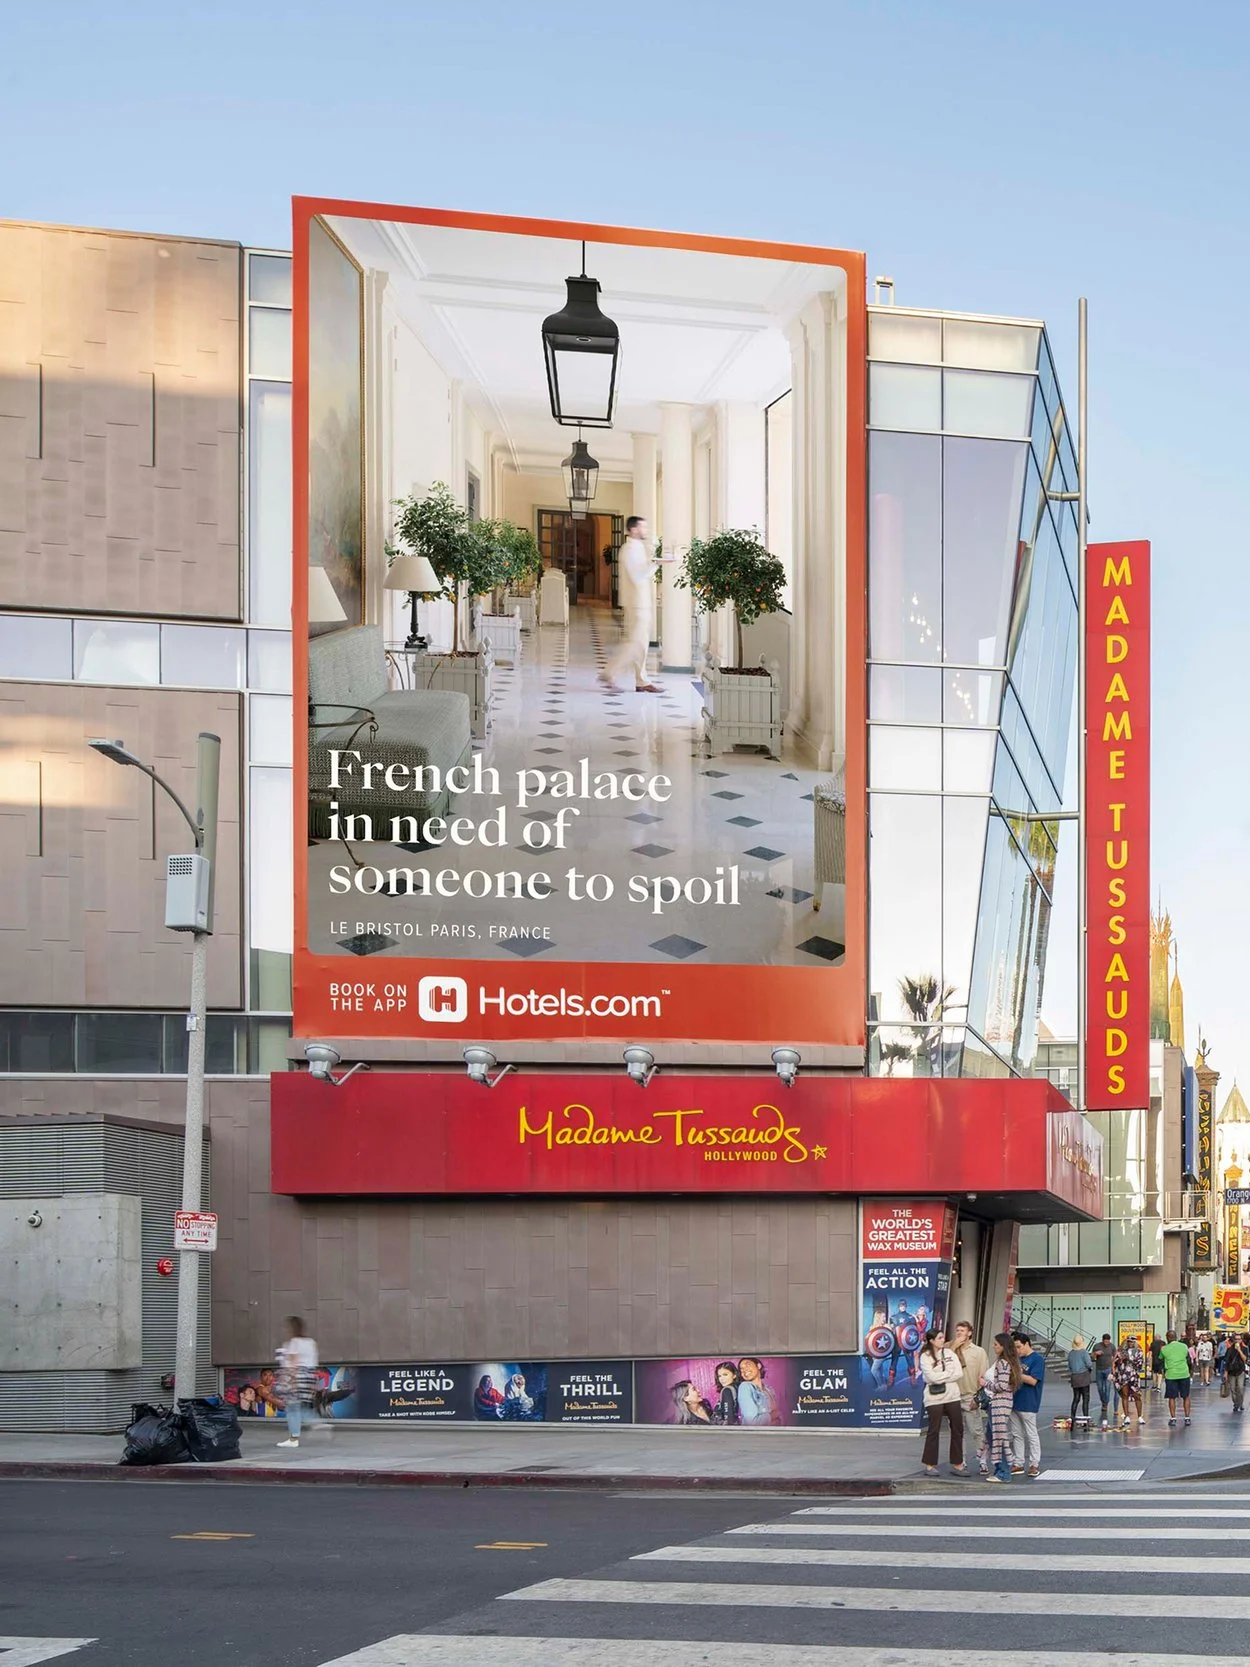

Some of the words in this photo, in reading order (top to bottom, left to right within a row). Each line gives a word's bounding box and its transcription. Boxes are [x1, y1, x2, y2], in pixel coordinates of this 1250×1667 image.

[1103, 556, 1132, 779] MADAME
[327, 749, 500, 796] French
[517, 758, 672, 808] palace
[328, 803, 375, 843] in
[390, 806, 508, 847] need
[522, 807, 580, 849] of
[328, 865, 552, 901] someone
[566, 869, 615, 902] to
[627, 865, 741, 914] spoil
[330, 921, 349, 936] LE
[354, 921, 425, 938] BRISTOL
[430, 923, 482, 940] PARIS,
[489, 925, 551, 940] FRANCE
[1105, 803, 1130, 1095] TUSSAUDS
[330, 983, 377, 998] BOOK
[384, 984, 407, 998] ON
[329, 997, 368, 1012] THE
[373, 998, 407, 1012] APP
[519, 1104, 662, 1150] Madame
[653, 1104, 808, 1163] Tussauds
[704, 1151, 778, 1161] HOLLYWOOD
[892, 1209, 912, 1218] THE
[177, 1219, 190, 1229] NO
[191, 1221, 215, 1230] STOPPING
[871, 1219, 933, 1230] WORLD'S
[868, 1230, 936, 1241] GREATEST
[867, 1242, 892, 1251] WAX
[893, 1242, 937, 1250] MUSEUM
[866, 1276, 929, 1289] ACTION
[389, 1370, 412, 1378] FEEL
[438, 1369, 446, 1377] A
[595, 1374, 613, 1382] THE
[803, 1369, 825, 1377] FEEL
[381, 1378, 455, 1393] LEGEND
[560, 1383, 623, 1397] THRILL
[800, 1377, 847, 1390] GLAM
